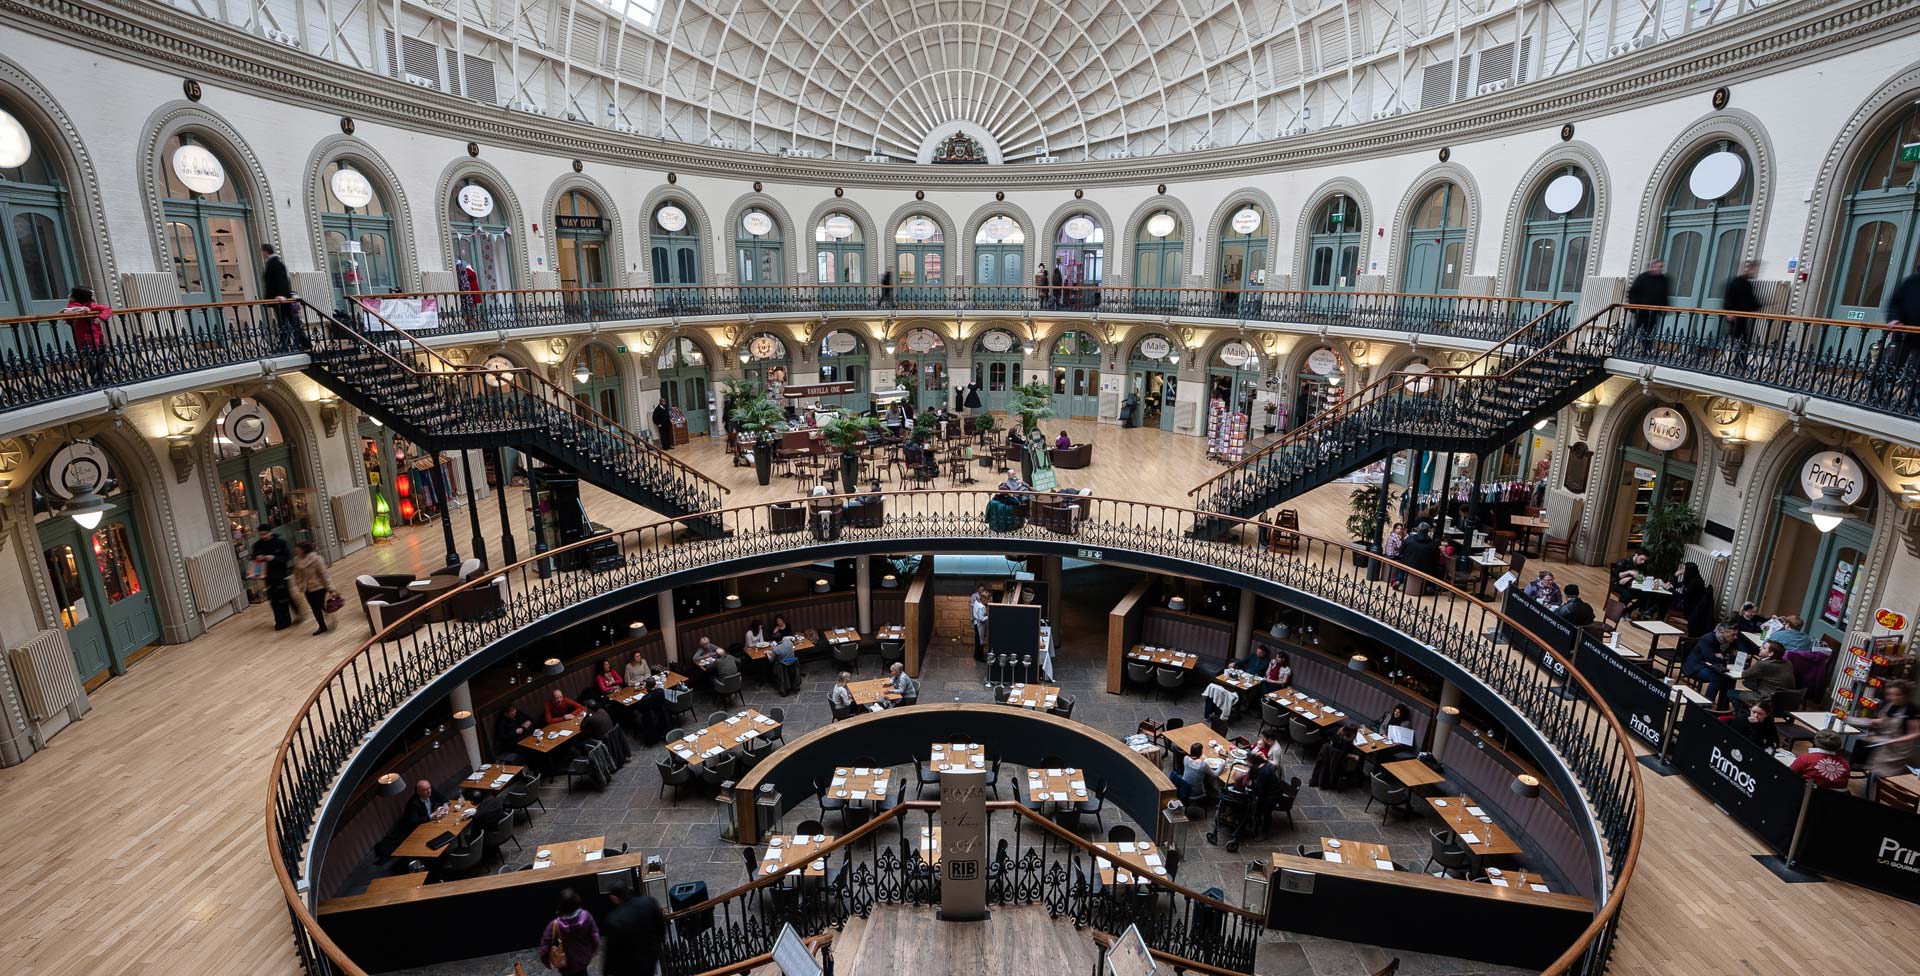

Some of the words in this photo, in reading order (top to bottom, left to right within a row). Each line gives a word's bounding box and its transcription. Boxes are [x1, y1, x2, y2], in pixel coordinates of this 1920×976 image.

[188, 82, 201, 97] 15
[1715, 92, 1723, 105] 2
[1563, 127, 1571, 137] 3
[573, 161, 583, 171] 12
[561, 217, 579, 227] WAY
[580, 218, 597, 228] OUT
[1144, 342, 1167, 351] iMale
[1223, 346, 1246, 359] iMale
[807, 386, 829, 395] VANILLA
[1583, 640, 1601, 656] ARTISAN
[1608, 657, 1624, 671] CREAM
[1627, 669, 1649, 687] BESPOKE
[1648, 683, 1667, 699] COFFEE
[952, 862, 976, 875] RIB
[1890, 861, 1920, 874] GOURME
